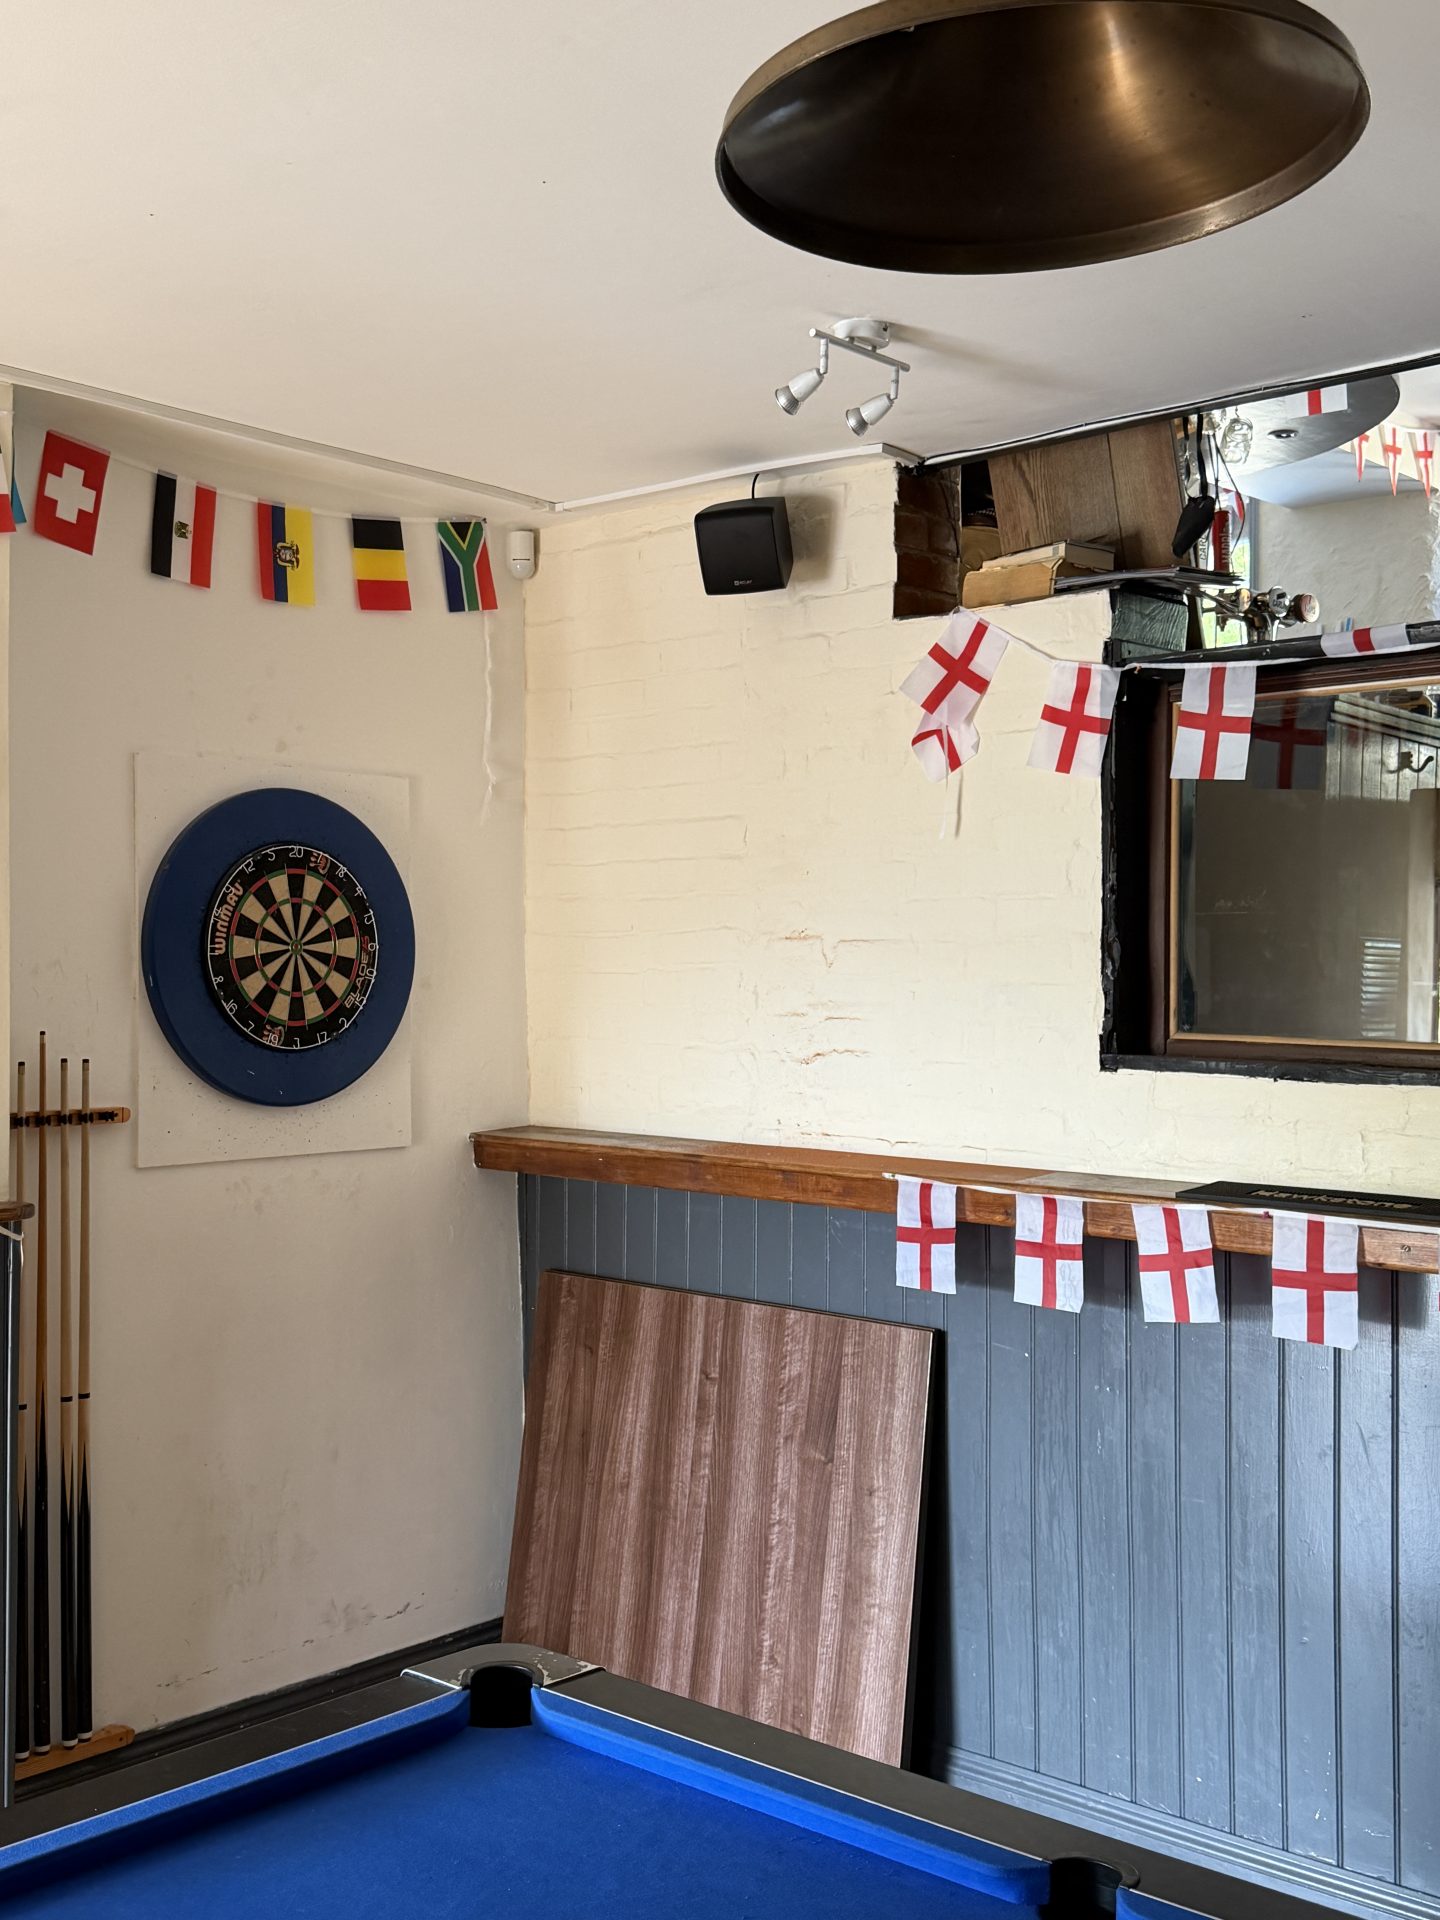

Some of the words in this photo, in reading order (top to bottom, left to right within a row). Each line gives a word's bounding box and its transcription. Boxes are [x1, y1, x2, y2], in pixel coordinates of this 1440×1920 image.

[267, 850, 276, 861] 5
[288, 846, 304, 858] 20
[242, 859, 256, 874] 12
[335, 866, 347, 878] 18
[224, 884, 235, 896] 9
[354, 886, 363, 897] 4
[212, 975, 224, 985] 8
[364, 968, 377, 981] 10
[226, 999, 238, 1015] 16
[266, 1032, 279, 1047] 19
[316, 1031, 328, 1045] 17
